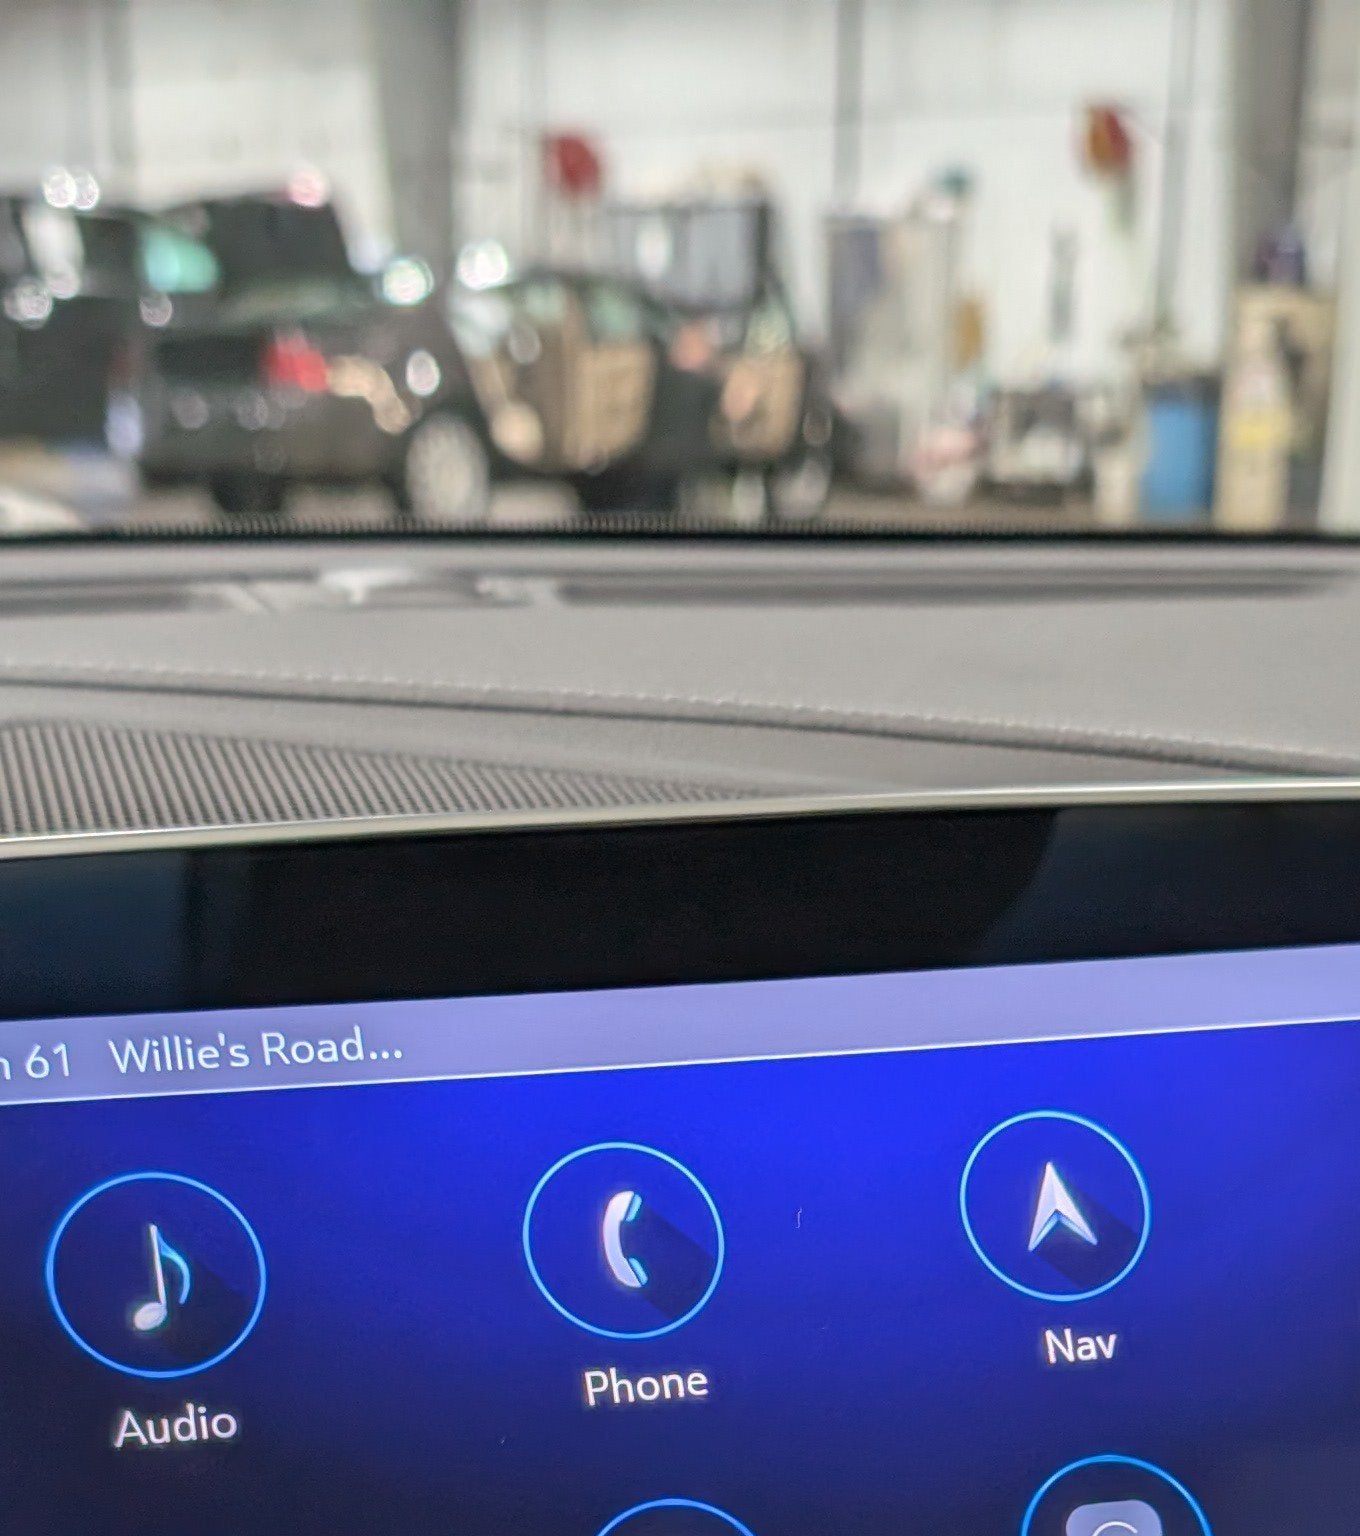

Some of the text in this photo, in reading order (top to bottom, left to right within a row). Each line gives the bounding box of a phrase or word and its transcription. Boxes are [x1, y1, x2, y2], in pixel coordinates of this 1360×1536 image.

[25, 1043, 72, 1078] 61
[108, 1034, 250, 1075] Willie's
[261, 1026, 403, 1063] Road...
[1046, 1329, 1118, 1363] Nav
[584, 1368, 709, 1406] Phone
[113, 1403, 237, 1448] Audio
